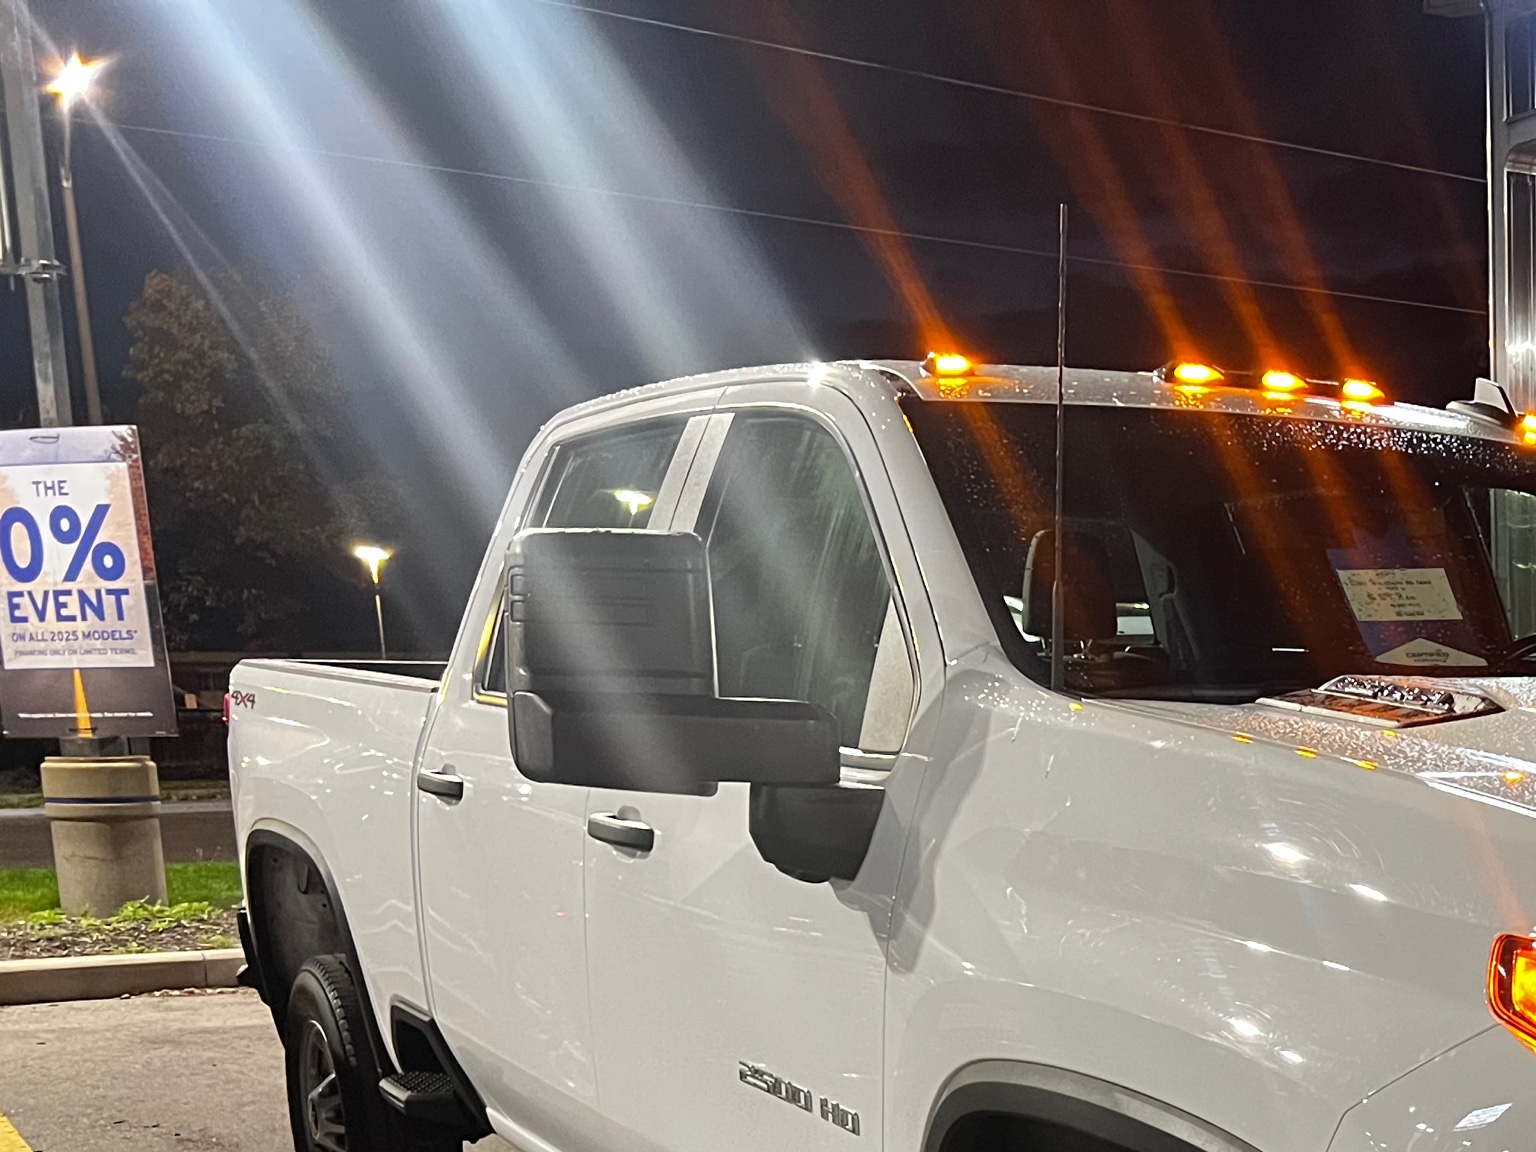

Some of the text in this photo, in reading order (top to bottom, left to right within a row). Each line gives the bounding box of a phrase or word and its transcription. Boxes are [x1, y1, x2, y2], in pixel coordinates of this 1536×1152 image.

[31, 480, 69, 497] THE
[0, 503, 126, 584] 0%
[6, 588, 130, 623] EVENT
[11, 631, 26, 643] ON
[28, 630, 48, 642] ALL
[50, 630, 79, 642] 2025
[819, 1096, 860, 1137] HD
